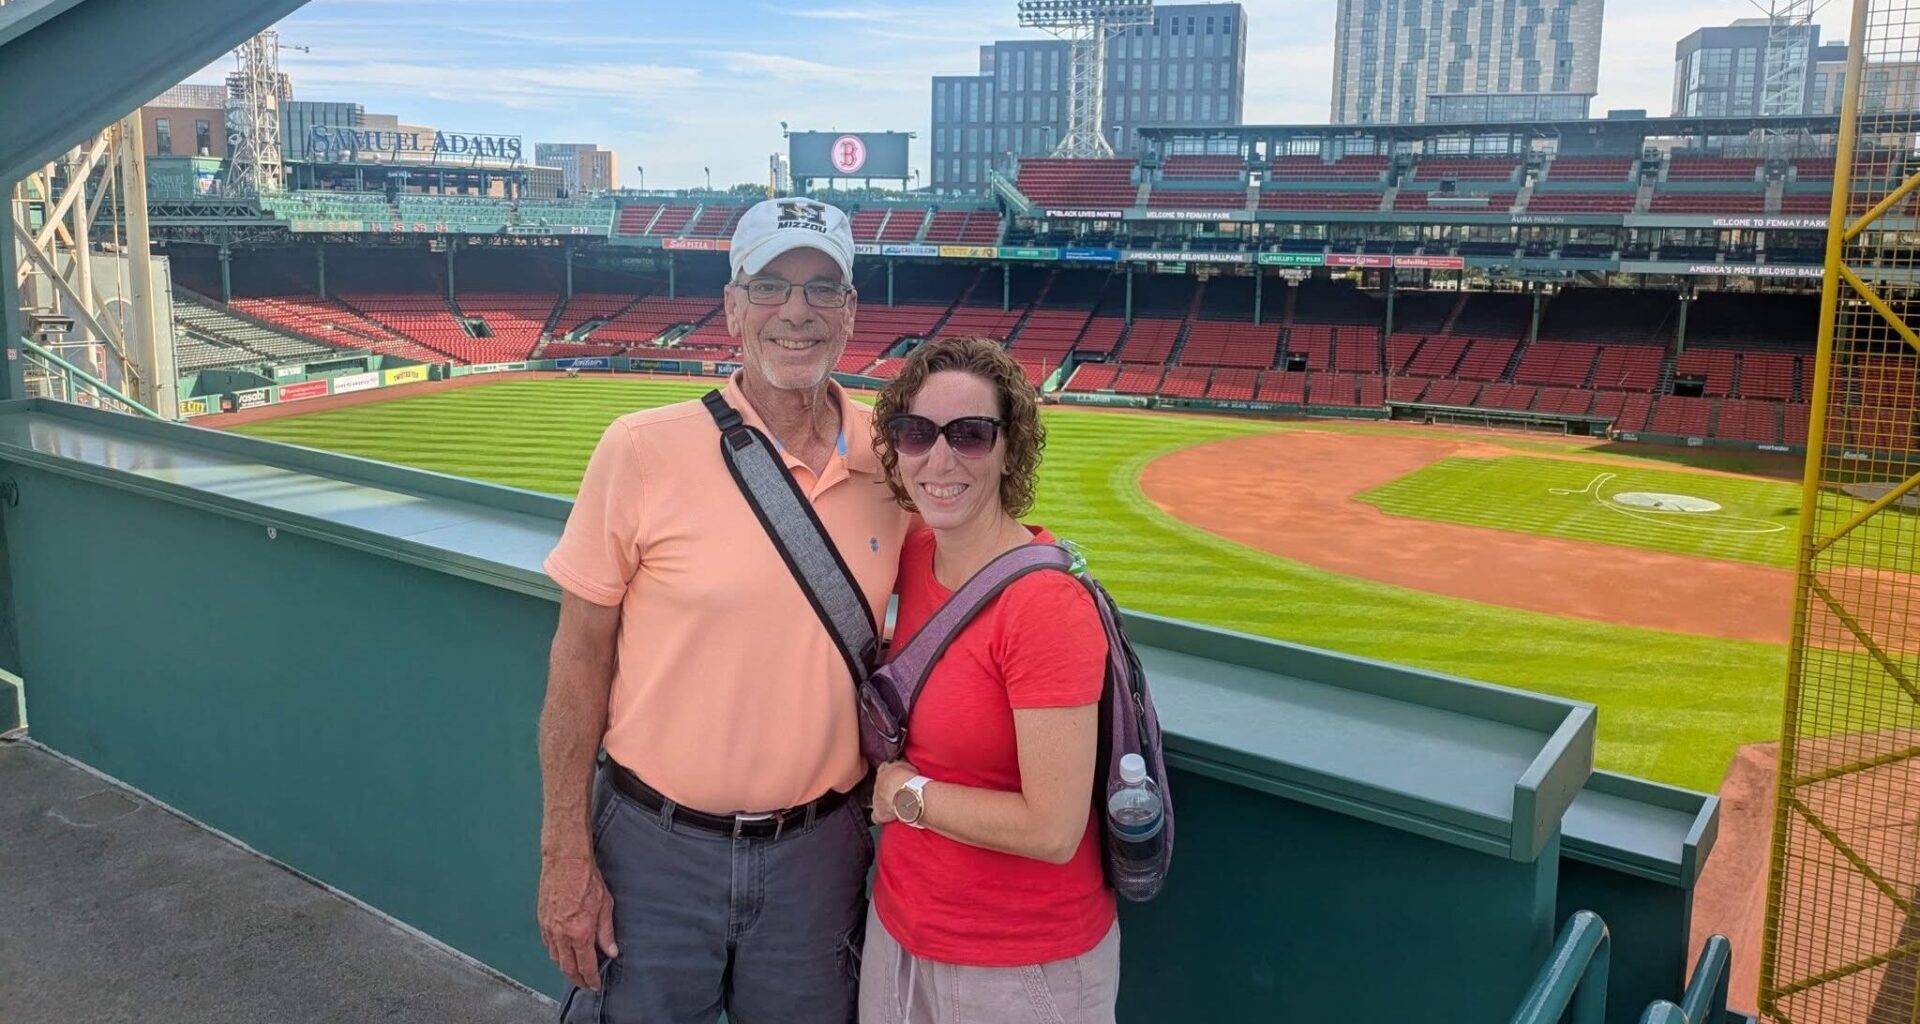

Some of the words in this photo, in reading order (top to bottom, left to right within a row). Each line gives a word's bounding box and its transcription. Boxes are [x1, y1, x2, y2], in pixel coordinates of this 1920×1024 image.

[312, 125, 425, 152] SAMUEL
[432, 130, 521, 159] ADAMS
[840, 141, 857, 167] B
[778, 221, 827, 234] MIZZOU
[1712, 218, 1750, 226] WELCOME
[1766, 219, 1800, 227] FENWAY
[570, 226, 588, 234] 2:37
[1734, 266, 1756, 274] MOST
[1759, 267, 1796, 275] BELOVED
[1798, 268, 1825, 276] BALLP
